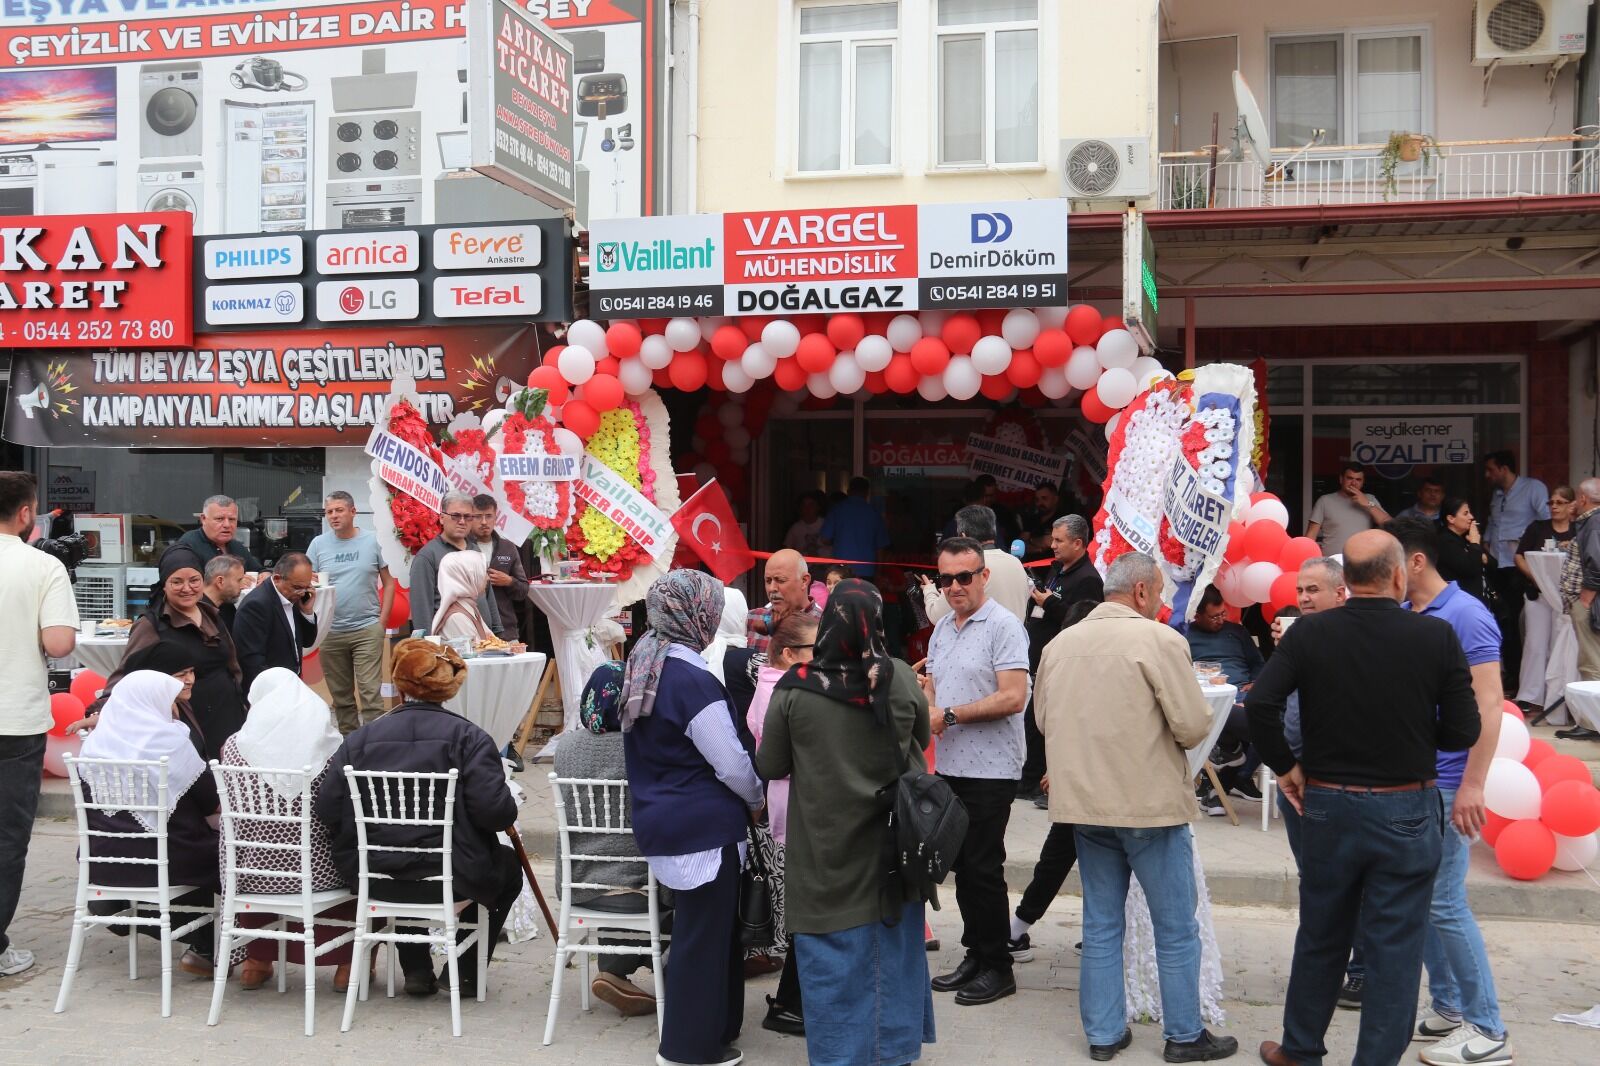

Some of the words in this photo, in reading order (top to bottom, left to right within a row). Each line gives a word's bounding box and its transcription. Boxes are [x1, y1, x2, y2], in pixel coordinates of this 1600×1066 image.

[9, 24, 151, 64] ÇEYİZLİK
[158, 26, 201, 49] VE
[211, 11, 340, 47] EVİNİZE
[350, 3, 434, 36] DAİR
[501, 13, 566, 82] ARIKAN
[497, 38, 570, 116] TİCARET
[743, 211, 897, 246] VARGEL
[326, 240, 409, 266] arnica
[449, 231, 523, 256] ferre
[620, 237, 716, 272] Vaillant
[215, 247, 292, 268] PHILIPS
[487, 255, 525, 264] Ankastre
[743, 251, 896, 277] MÜHENDİSLİK
[930, 247, 1056, 270] DemirDöküm
[212, 298, 272, 312] KORKMAZ
[369, 290, 397, 310] LG
[450, 285, 526, 306] Tefal
[614, 296, 645, 311] 0541
[647, 295, 675, 310] 284
[677, 295, 691, 309] 19
[692, 294, 713, 309] 46
[737, 284, 904, 312] DOĞALGAZ
[945, 285, 983, 301] 0541
[986, 284, 1019, 299] 284
[1022, 283, 1038, 298] 19
[1040, 283, 1057, 298] 51
[24, 322, 71, 340] 0544
[77, 321, 113, 339] 252
[120, 321, 143, 339] 73
[150, 320, 174, 338] 80
[140, 350, 214, 383] BEYAZ
[218, 349, 280, 387] EŞYA
[282, 341, 446, 390] ÇEŞİTLERİNDE
[83, 395, 294, 427] KAMPANYALARIMIZ
[299, 393, 455, 432] BAŞLATIR
[1366, 422, 1453, 439] seydikemer
[371, 432, 430, 483] MENDOS
[382, 464, 414, 493] ÜMRAN
[414, 482, 439, 509] SEZGİN
[586, 463, 667, 539] Vaillant
[611, 509, 655, 546] GRUP
